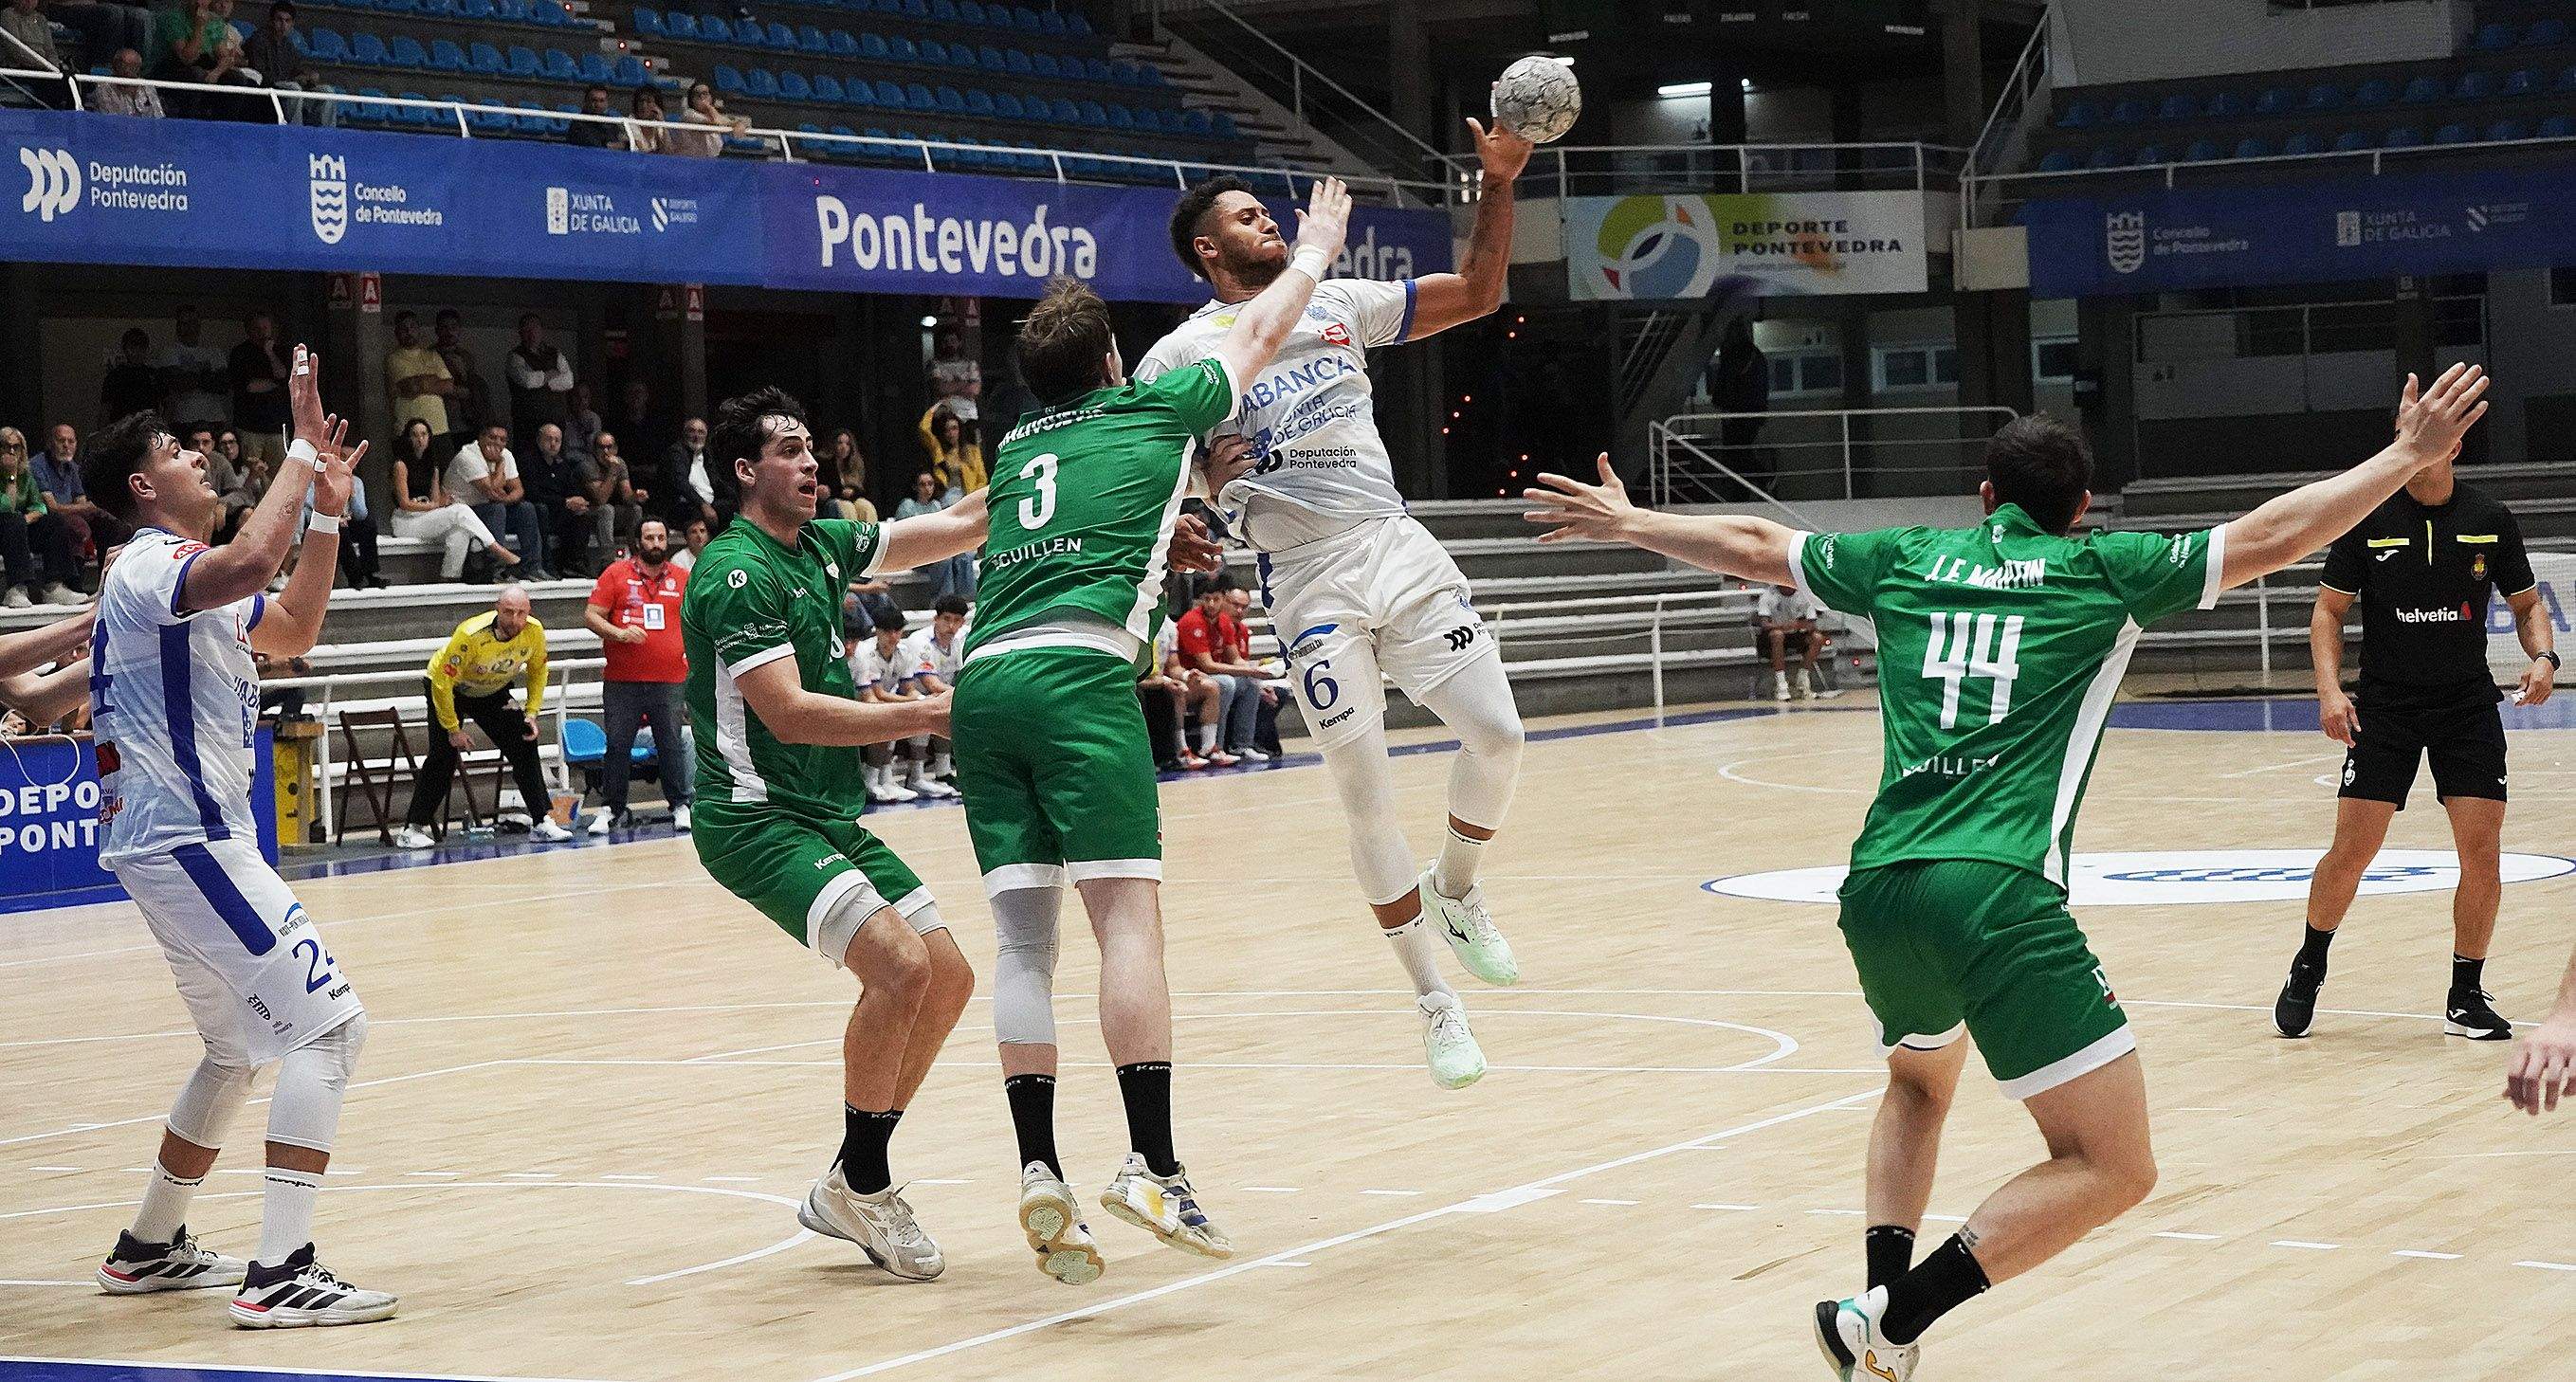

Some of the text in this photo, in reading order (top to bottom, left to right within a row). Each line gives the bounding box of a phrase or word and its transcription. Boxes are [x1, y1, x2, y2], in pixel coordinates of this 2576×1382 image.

[89, 160, 188, 188] Deputación
[90, 186, 189, 211] Pontevedra
[354, 182, 407, 203] Concello
[572, 193, 614, 212] XUNTA
[355, 206, 443, 227] de Pontevedra
[570, 213, 642, 234] DE GALICIA
[1732, 219, 1849, 236] DEPORTE
[815, 194, 1098, 279] Pontevedra
[1734, 239, 1904, 256] PONTEVEDRA
[1241, 355, 1358, 414] ABANCA
[1274, 404, 1357, 446] DE GALICIA
[1289, 446, 1357, 460] Deputación
[1289, 459, 1357, 469] Pontevedra
[1018, 453, 1059, 530] 3
[998, 537, 1082, 571] GUILLEN
[2395, 606, 2458, 623] helvetia
[1922, 611, 2025, 730] 44
[1304, 659, 1339, 711] 6
[1318, 706, 1356, 730] Kempa
[0, 780, 100, 818] DEPO
[0, 818, 98, 853] PONT
[813, 853, 848, 871] Kemp
[327, 982, 351, 1001] Kemp
[1137, 1064, 1172, 1074] Kem
